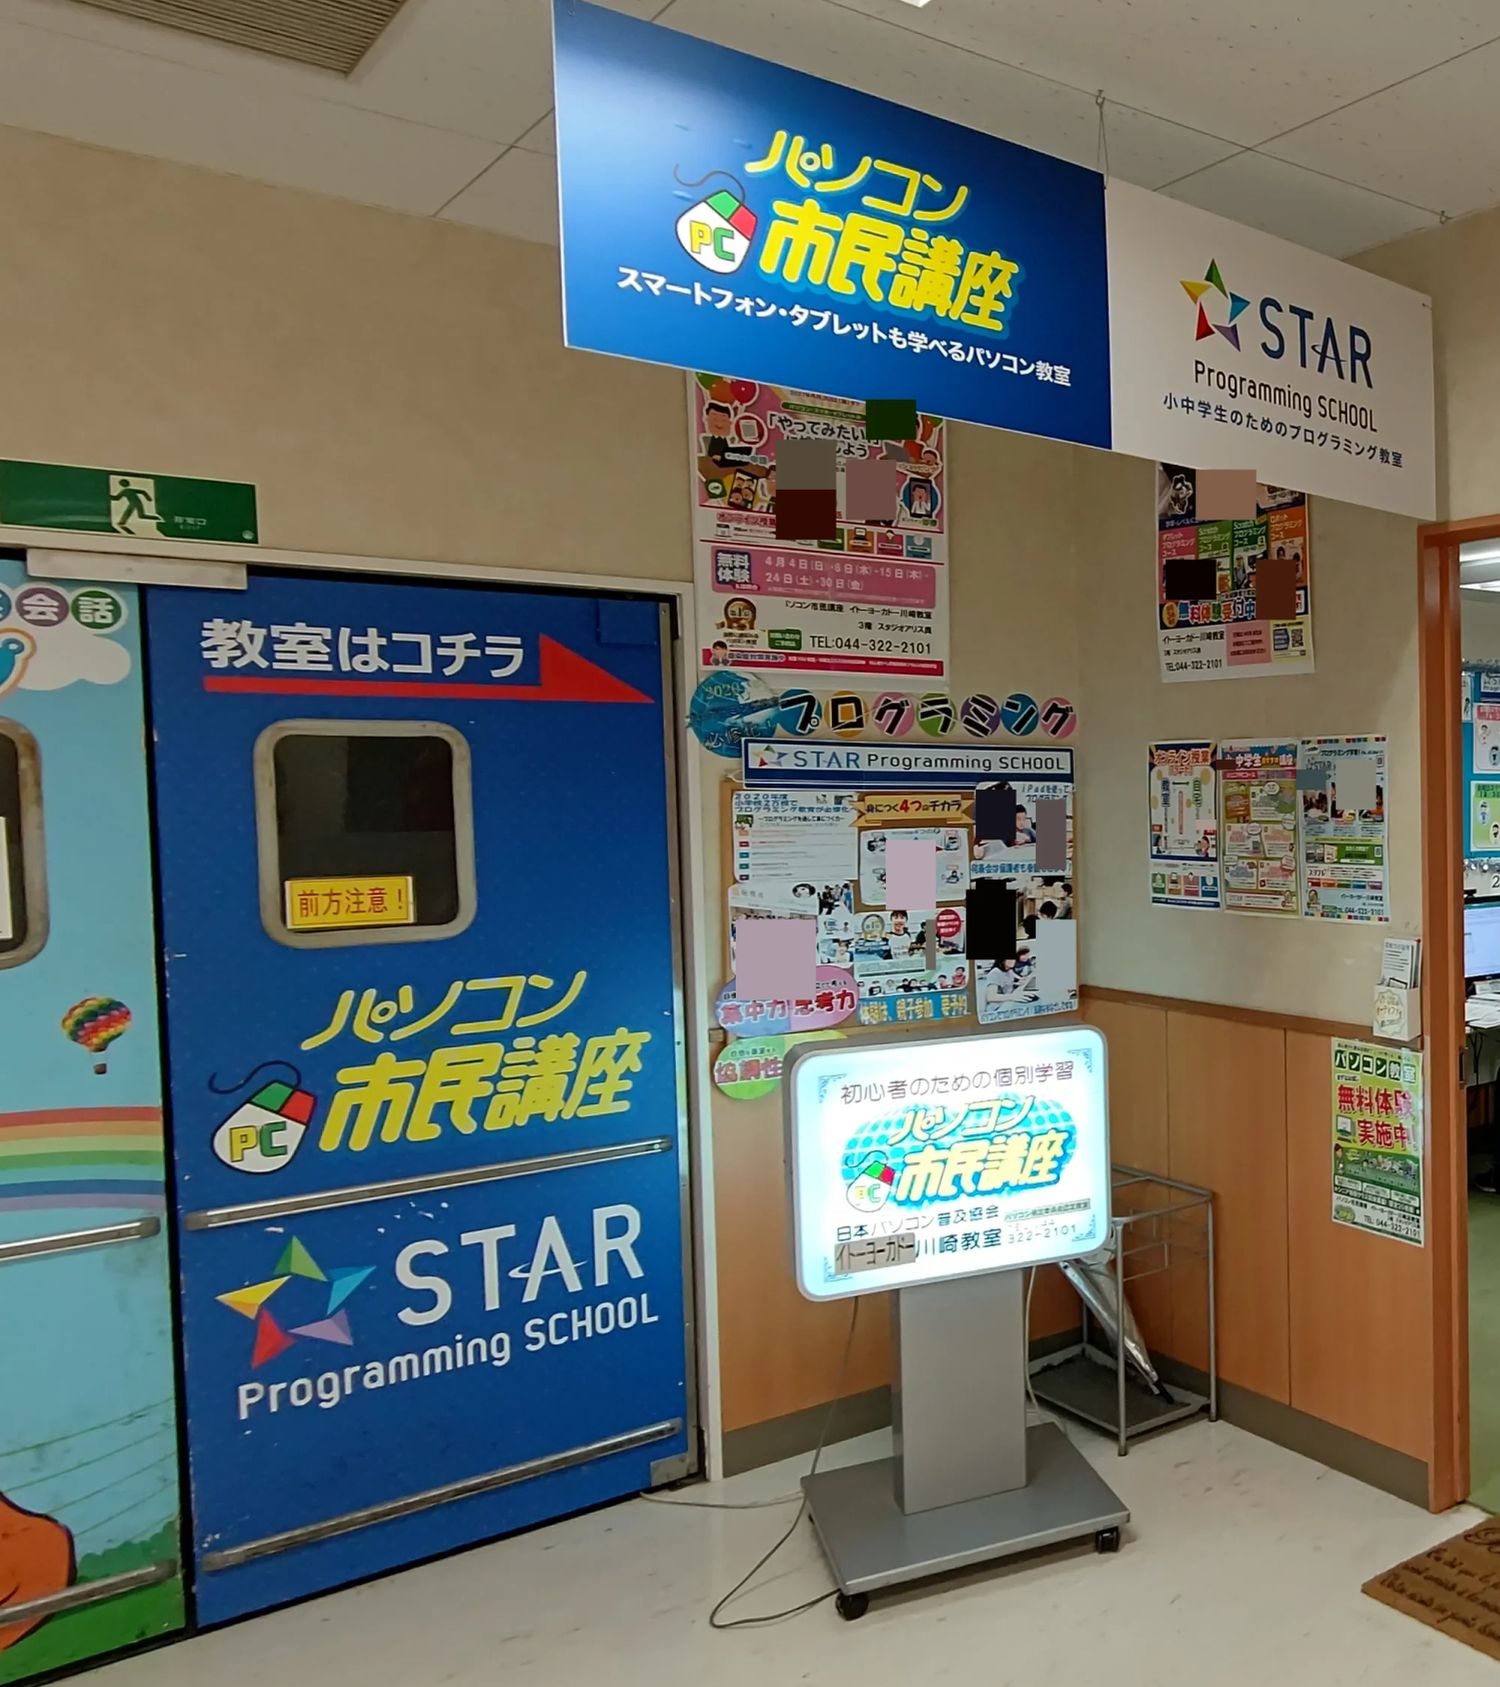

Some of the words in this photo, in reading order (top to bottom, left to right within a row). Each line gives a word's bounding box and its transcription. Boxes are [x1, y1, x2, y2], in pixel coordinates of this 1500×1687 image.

[744, 130, 969, 221] パソコン
[689, 219, 736, 263] PC
[759, 198, 1020, 332] 市民講座
[616, 266, 1072, 387] スマートフォン・タブレットも学べるパソコン教室
[1259, 297, 1374, 388] STAR
[1194, 360, 1312, 418] Programming
[1317, 395, 1378, 433] SCHOOL
[1163, 392, 1404, 468] 小中学生のためのプログラミング教室
[717, 551, 750, 567] 無料
[717, 567, 750, 584] 体験
[201, 618, 525, 679] 教室はコチラ
[810, 635, 932, 654] TEL:044-322-2101
[780, 691, 1075, 738] プログラミング
[793, 750, 860, 770] STAR
[867, 752, 993, 774] Programming
[998, 755, 1066, 772] SCHOOL
[298, 887, 405, 916] 前方注意！
[1491, 875, 1500, 888] 2
[300, 970, 586, 1051] パソコン
[319, 1028, 653, 1151] 市民講座
[841, 1060, 1075, 1105] 初心者のための個別学習
[1335, 1049, 1417, 1084] パソコン教室
[888, 1095, 1037, 1147] パソコン
[1337, 1083, 1414, 1117] 無料体験
[230, 1122, 288, 1163] PC
[896, 1128, 1070, 1202] 市民講座
[837, 1204, 1000, 1242] 日本パソコン普及協会
[394, 1203, 645, 1326] STAR
[237, 1332, 510, 1420] Programming
[524, 1294, 659, 1352] SCHOOL
